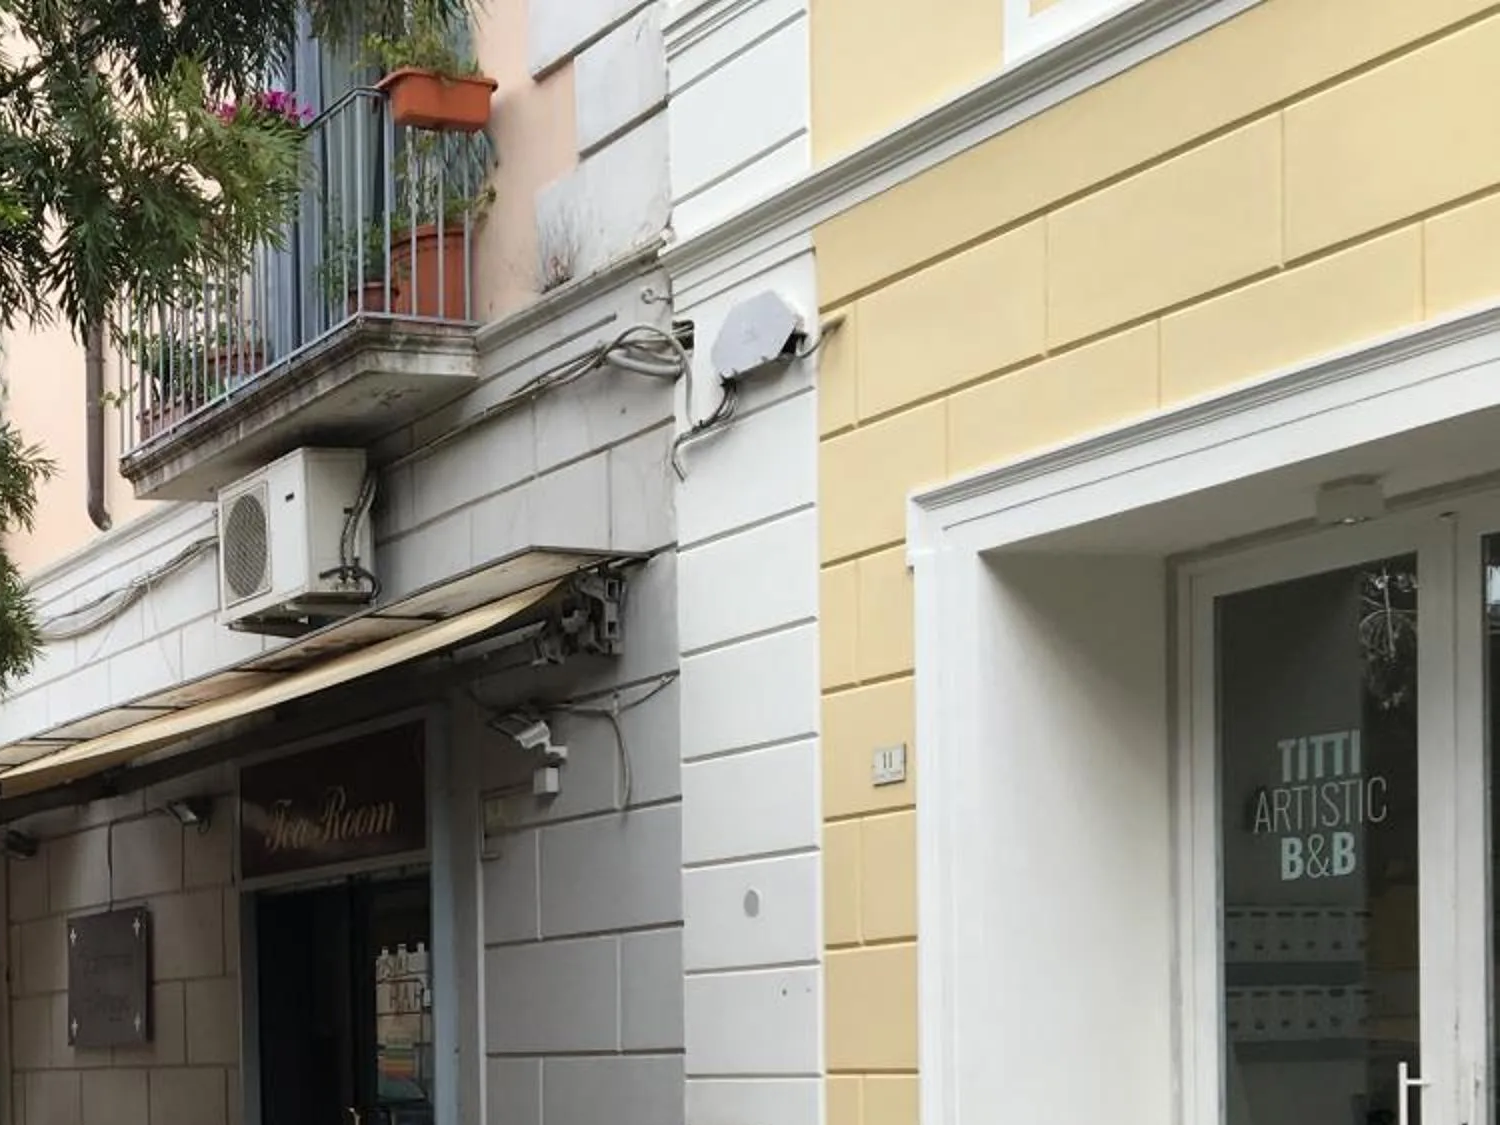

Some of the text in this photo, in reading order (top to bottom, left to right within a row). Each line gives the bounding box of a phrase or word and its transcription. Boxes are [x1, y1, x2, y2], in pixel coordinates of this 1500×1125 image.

[1277, 729, 1361, 782] TITTI
[265, 785, 396, 851] Tea Room
[1253, 776, 1388, 834] ARTISTIC
[1281, 831, 1357, 881] B&B
